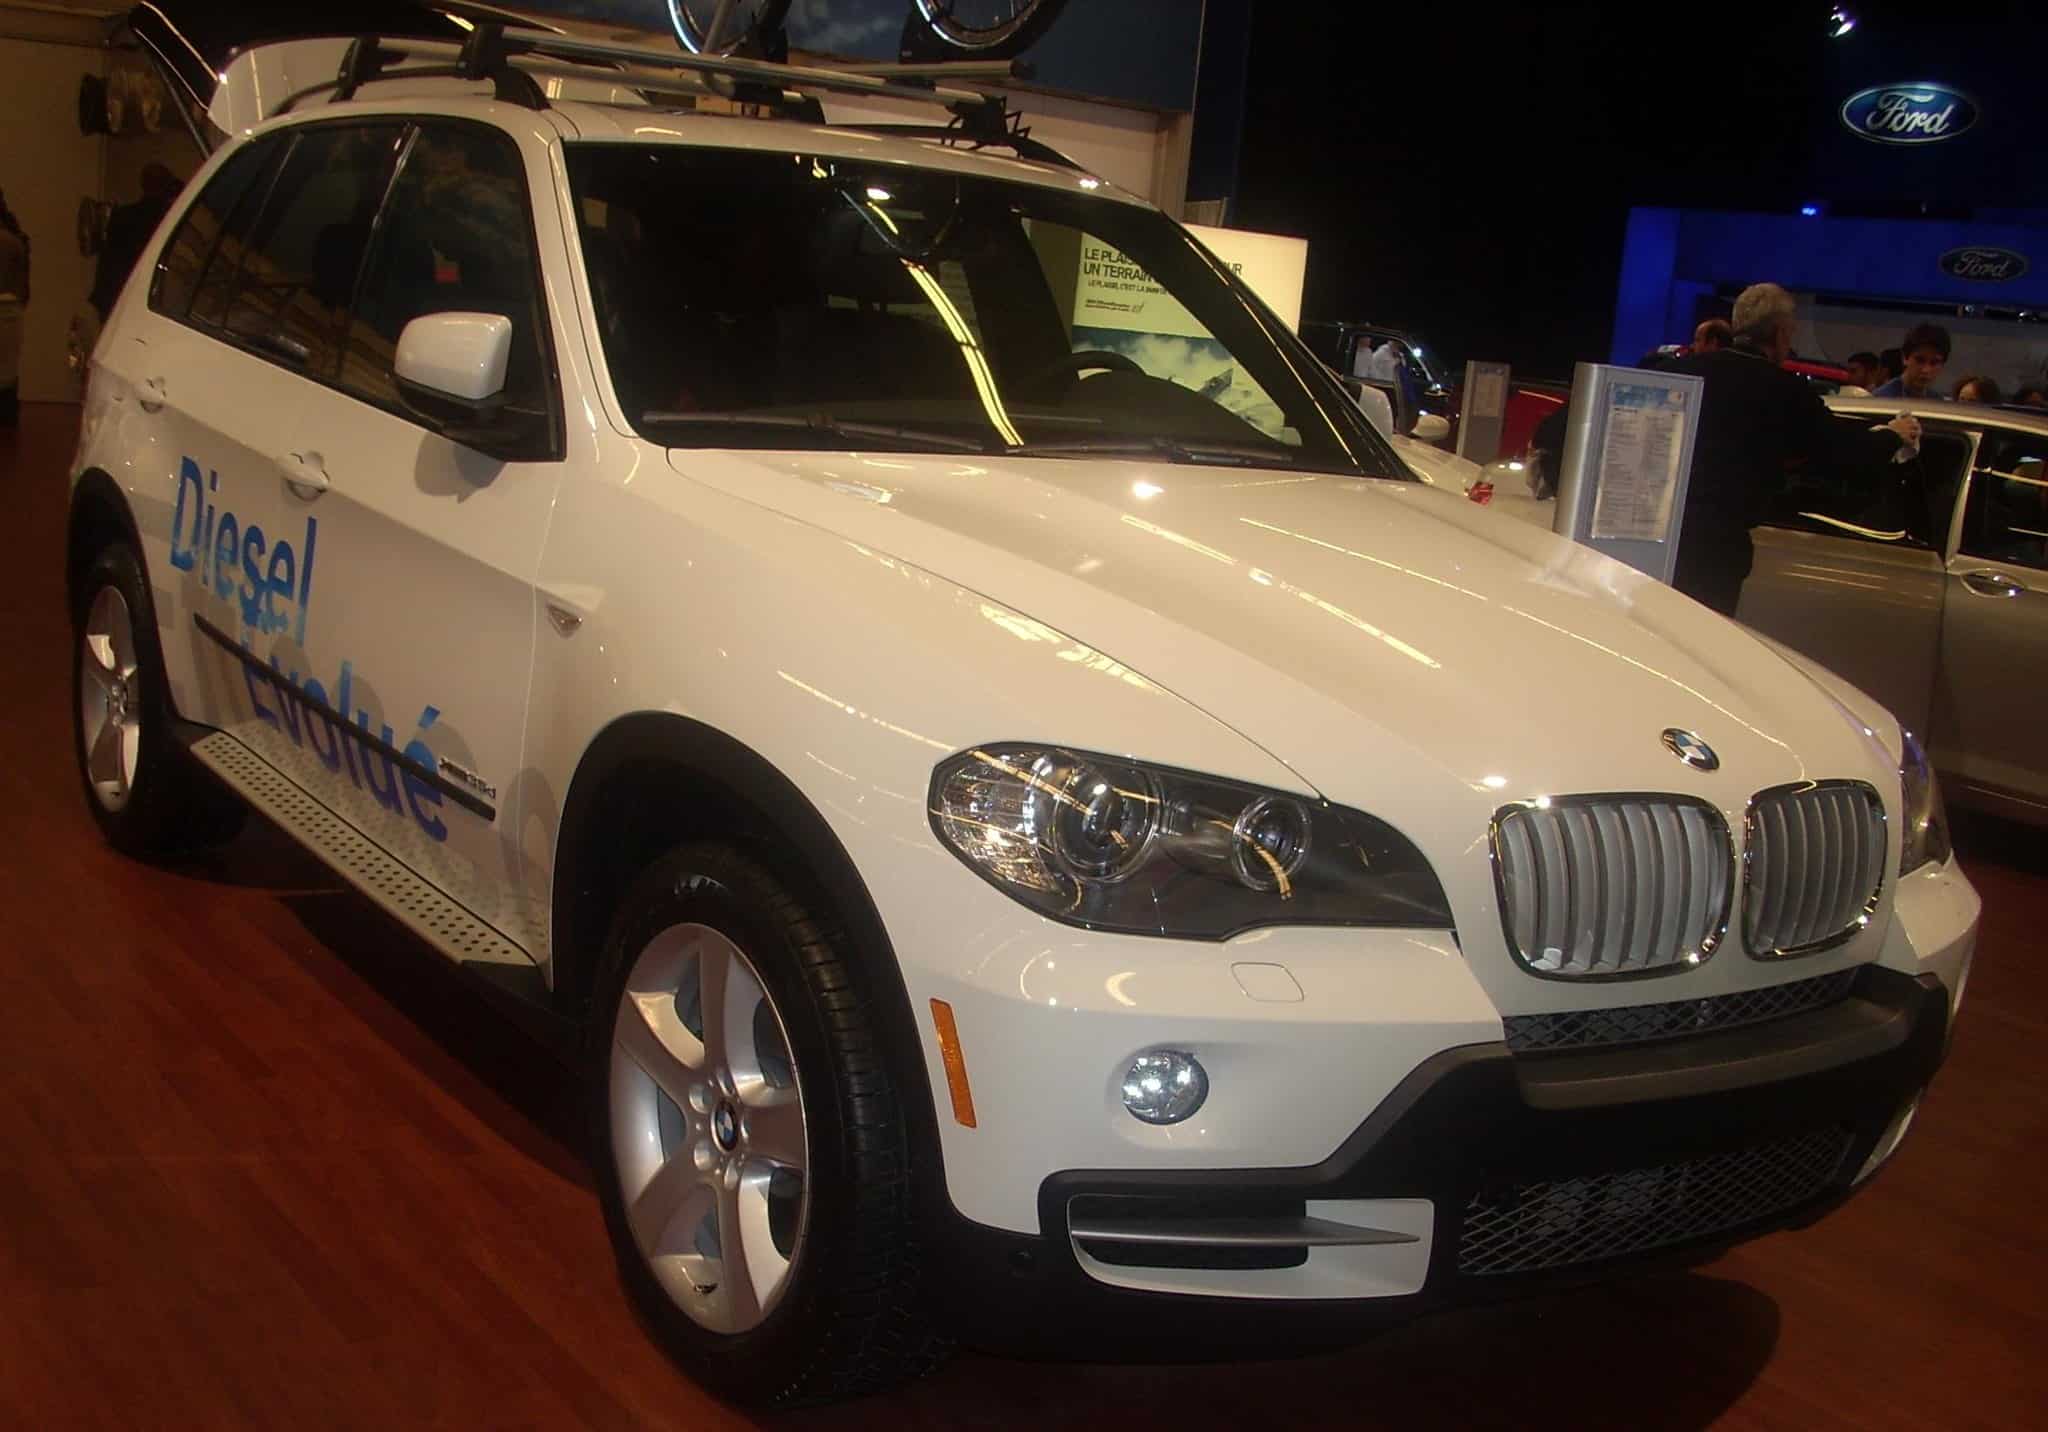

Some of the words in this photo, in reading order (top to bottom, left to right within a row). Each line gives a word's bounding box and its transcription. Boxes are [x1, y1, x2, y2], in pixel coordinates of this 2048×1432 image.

[1866, 91, 1954, 133] Ford
[1085, 247, 1099, 260] LE
[1953, 250, 2009, 277] Ford
[1084, 262, 1100, 276] UN
[171, 456, 317, 648] Diesel
